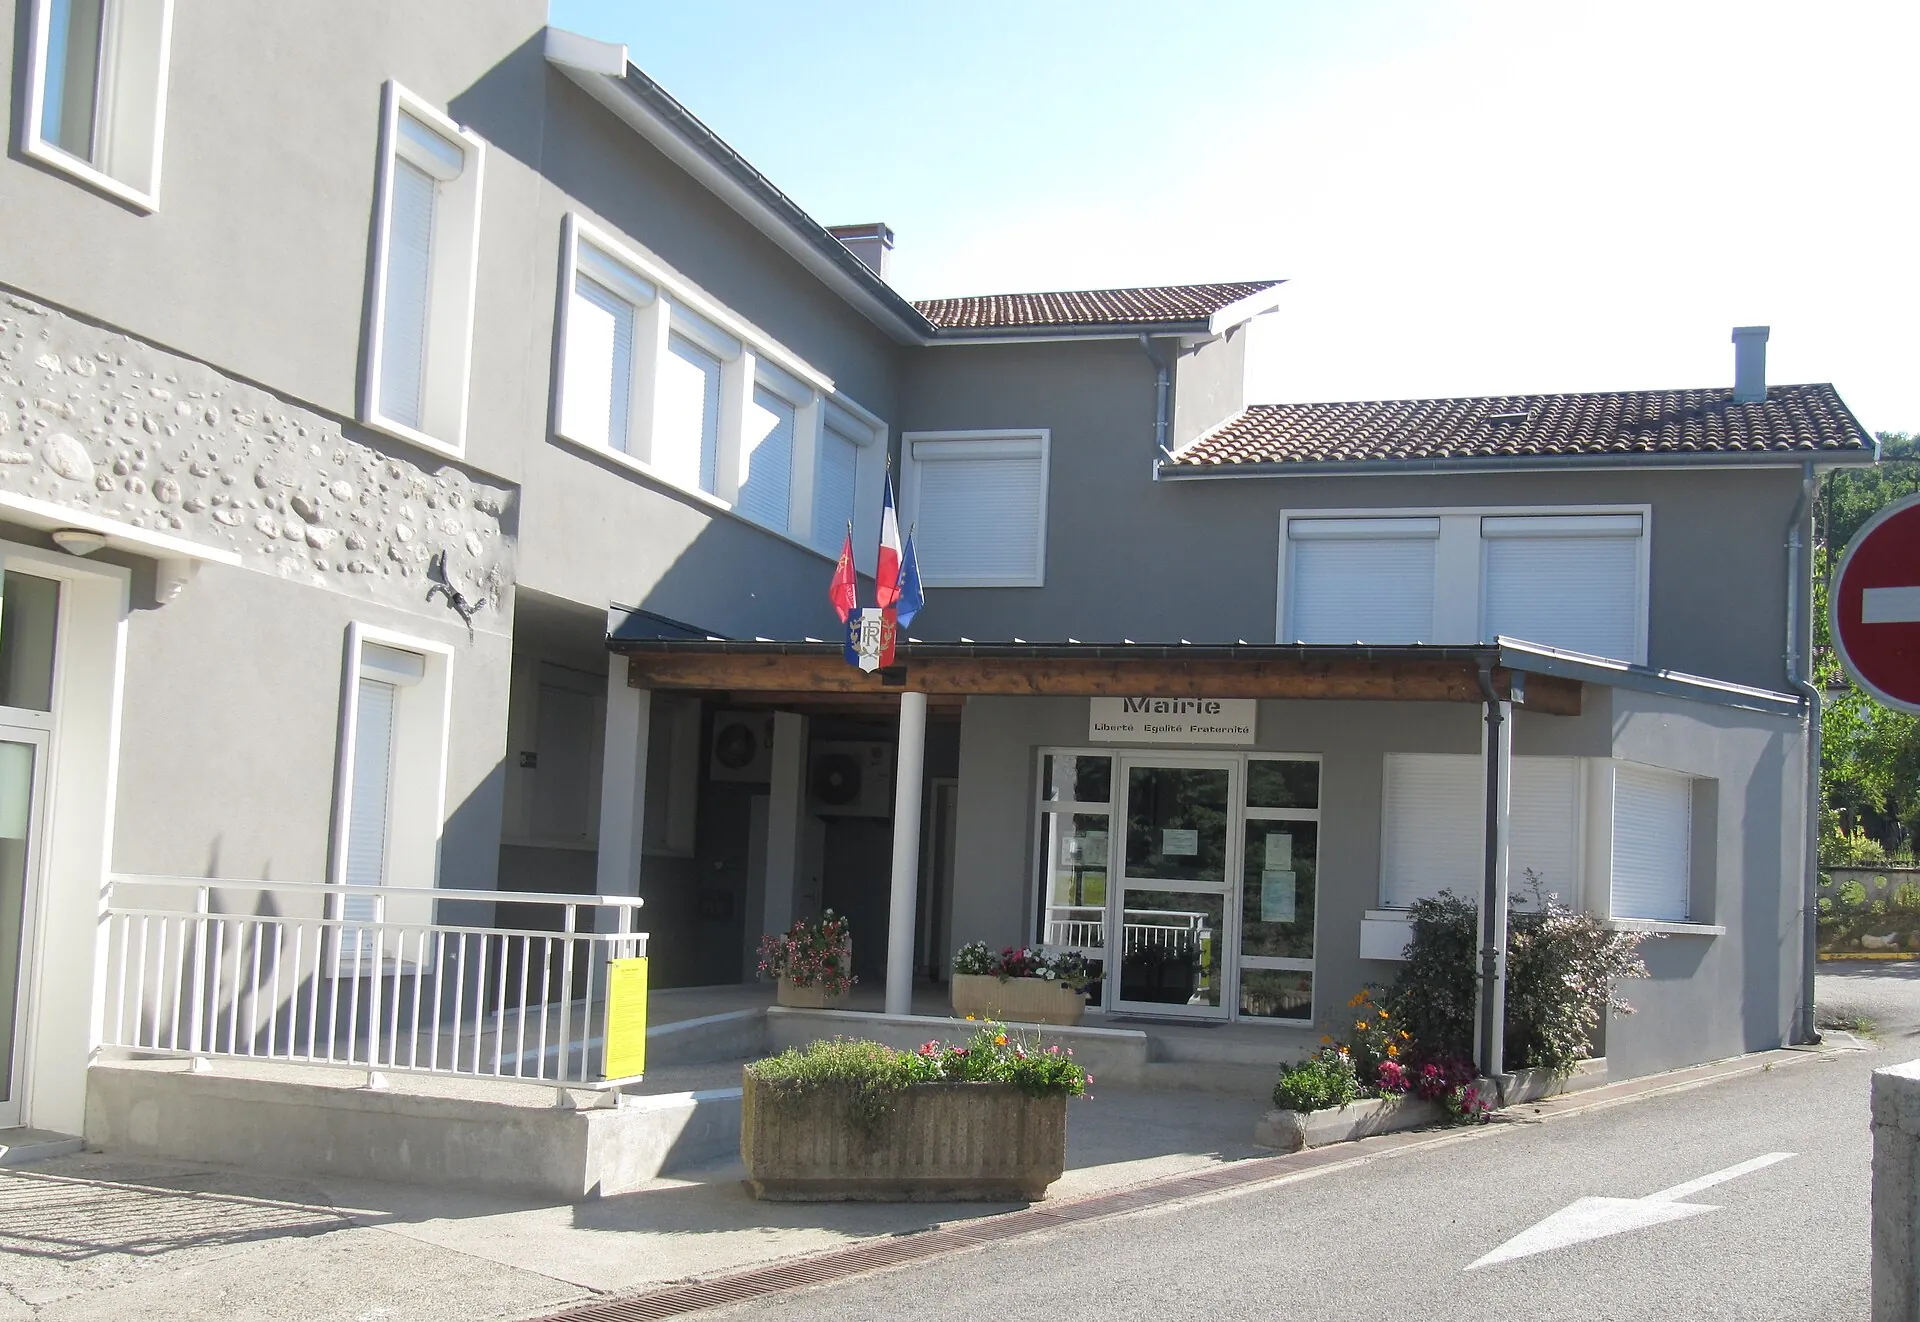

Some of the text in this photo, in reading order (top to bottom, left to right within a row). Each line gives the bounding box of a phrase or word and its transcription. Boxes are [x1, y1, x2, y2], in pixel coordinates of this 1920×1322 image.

[1123, 697, 1221, 714] Mairie
[1094, 723, 1249, 735] Liberté Egalité Fraternité
